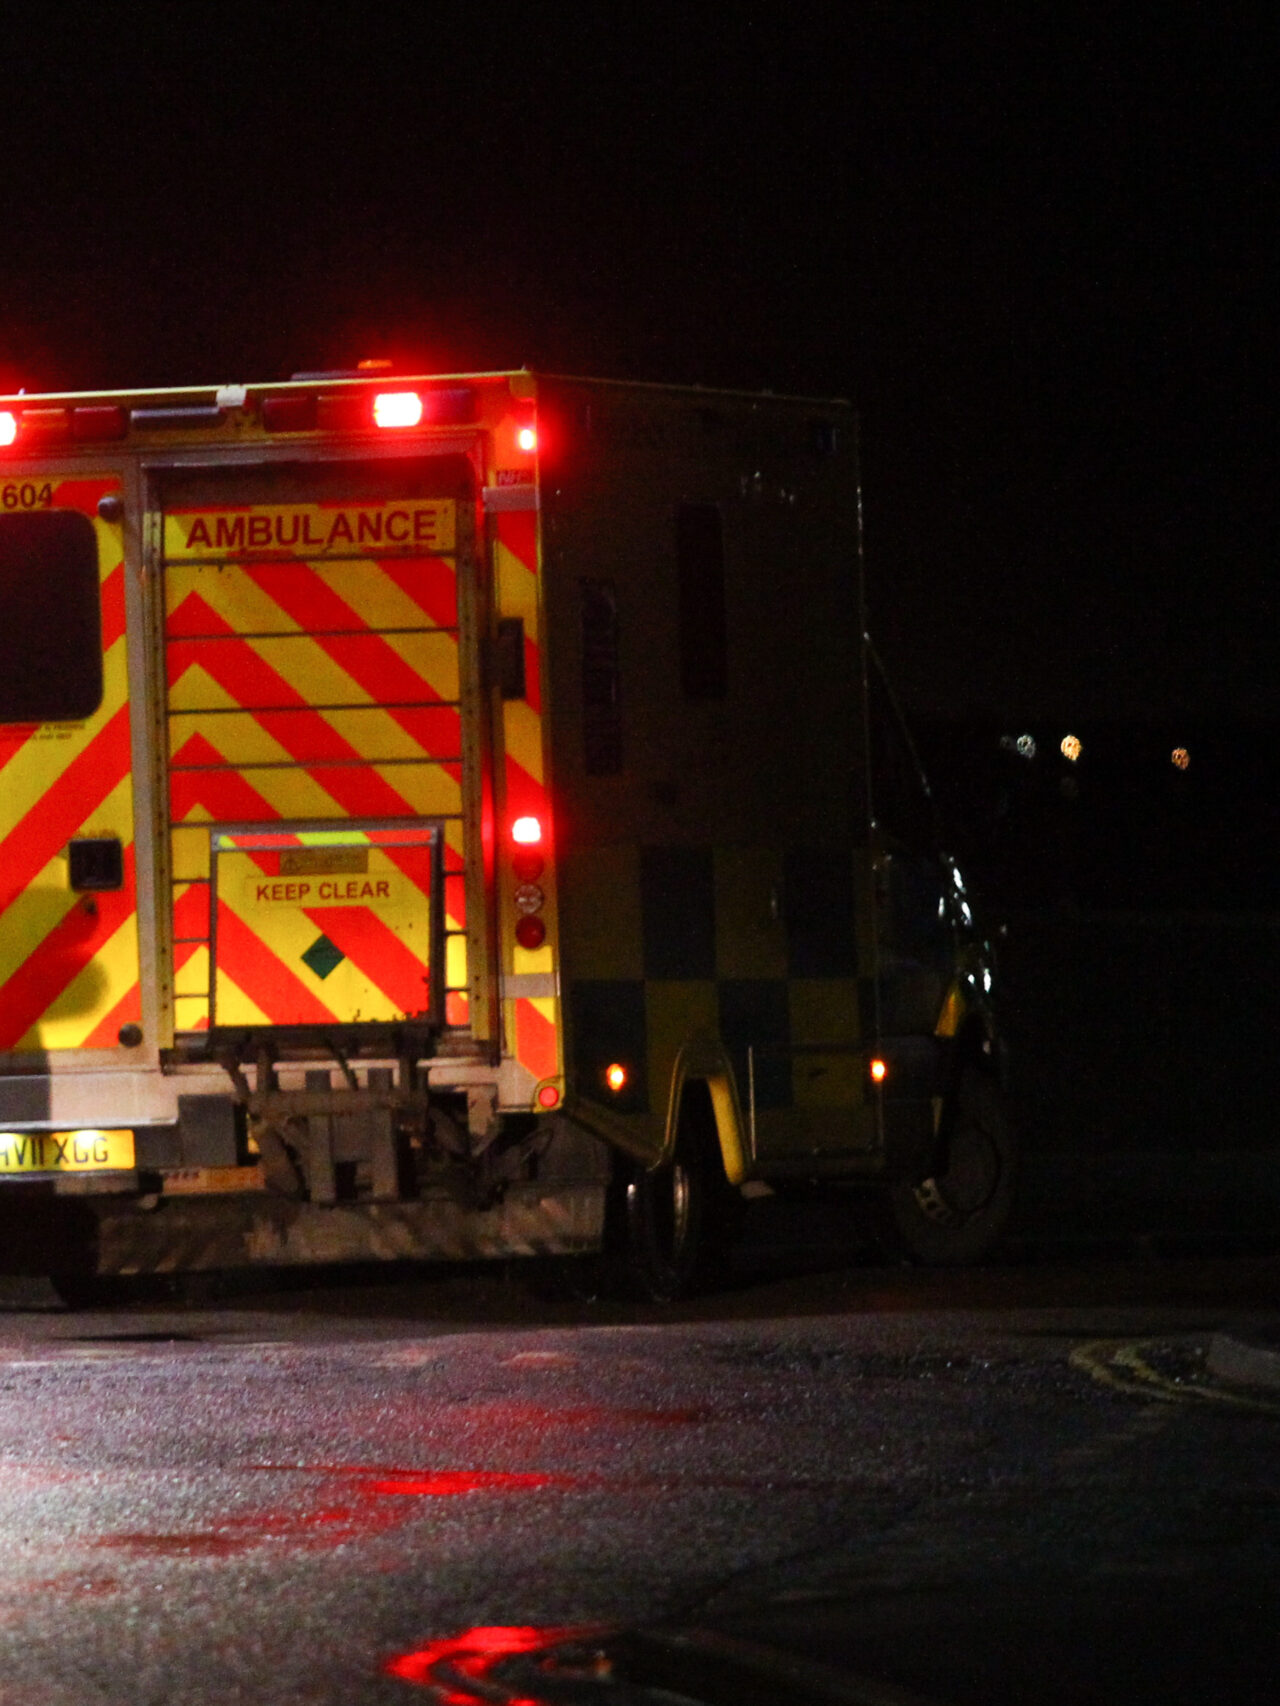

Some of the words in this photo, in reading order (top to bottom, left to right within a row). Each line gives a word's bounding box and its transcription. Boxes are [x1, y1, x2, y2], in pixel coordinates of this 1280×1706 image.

[1, 483, 53, 509] 604
[185, 510, 438, 549] AMBULANCE
[256, 883, 311, 901] KEEP
[318, 881, 390, 899] CLEAR
